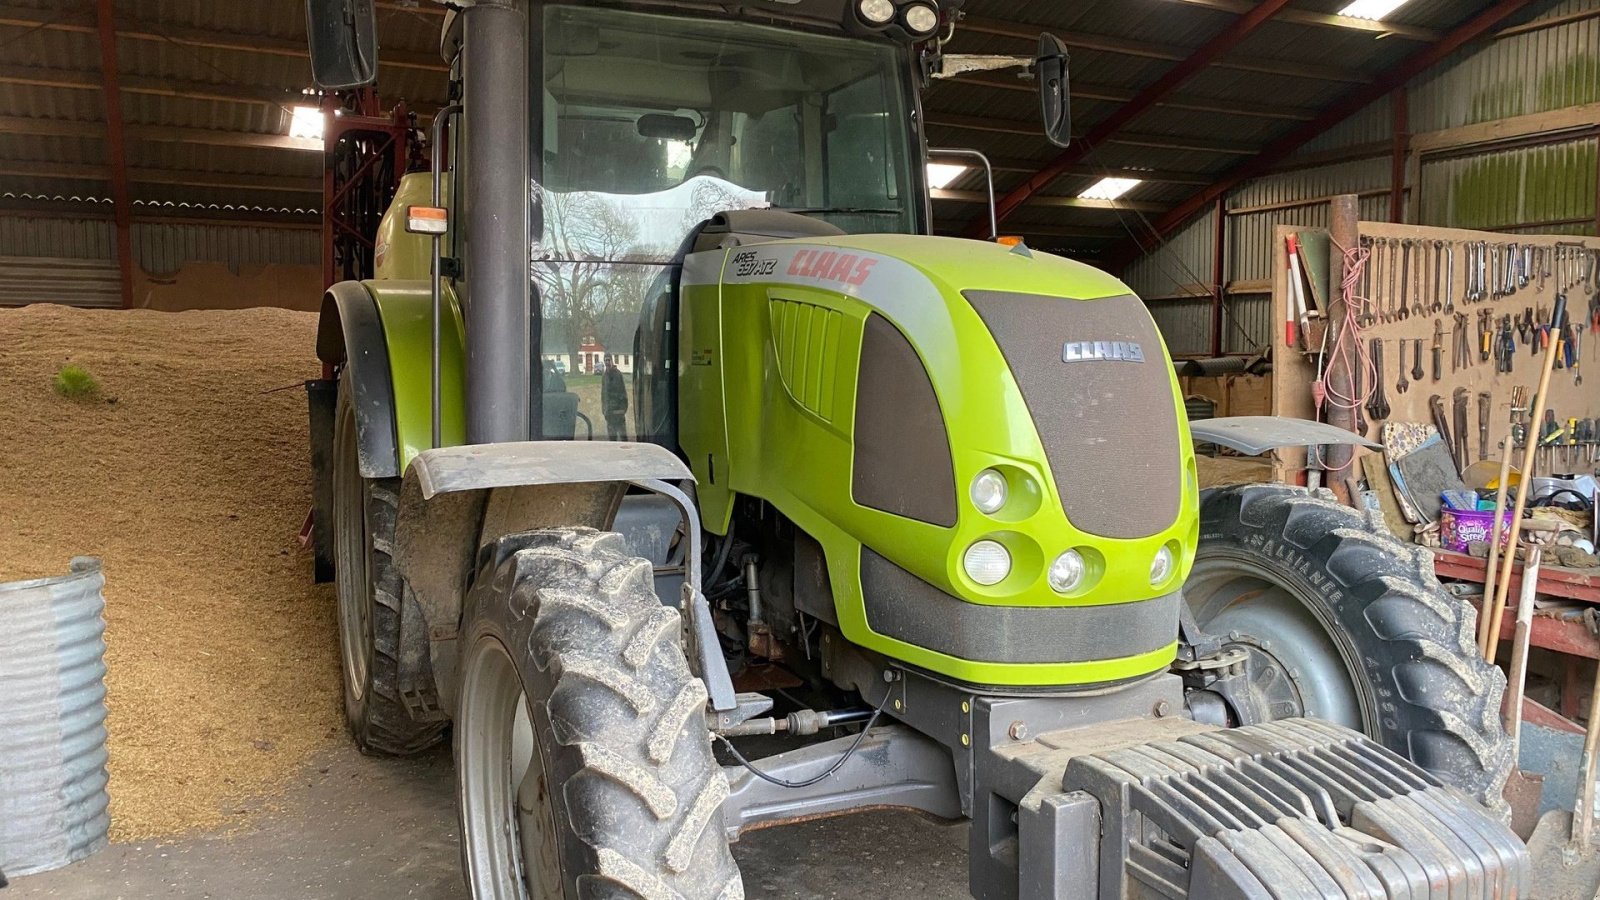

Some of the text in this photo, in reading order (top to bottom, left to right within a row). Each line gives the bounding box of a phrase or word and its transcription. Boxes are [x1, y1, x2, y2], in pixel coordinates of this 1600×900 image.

[732, 251, 757, 264] ARES
[786, 249, 878, 286] CLAAS
[1065, 341, 1143, 361] CLAAS
[1458, 524, 1488, 536] Quality
[1460, 533, 1486, 542] Street
[1262, 540, 1343, 603] ALLIANCE
